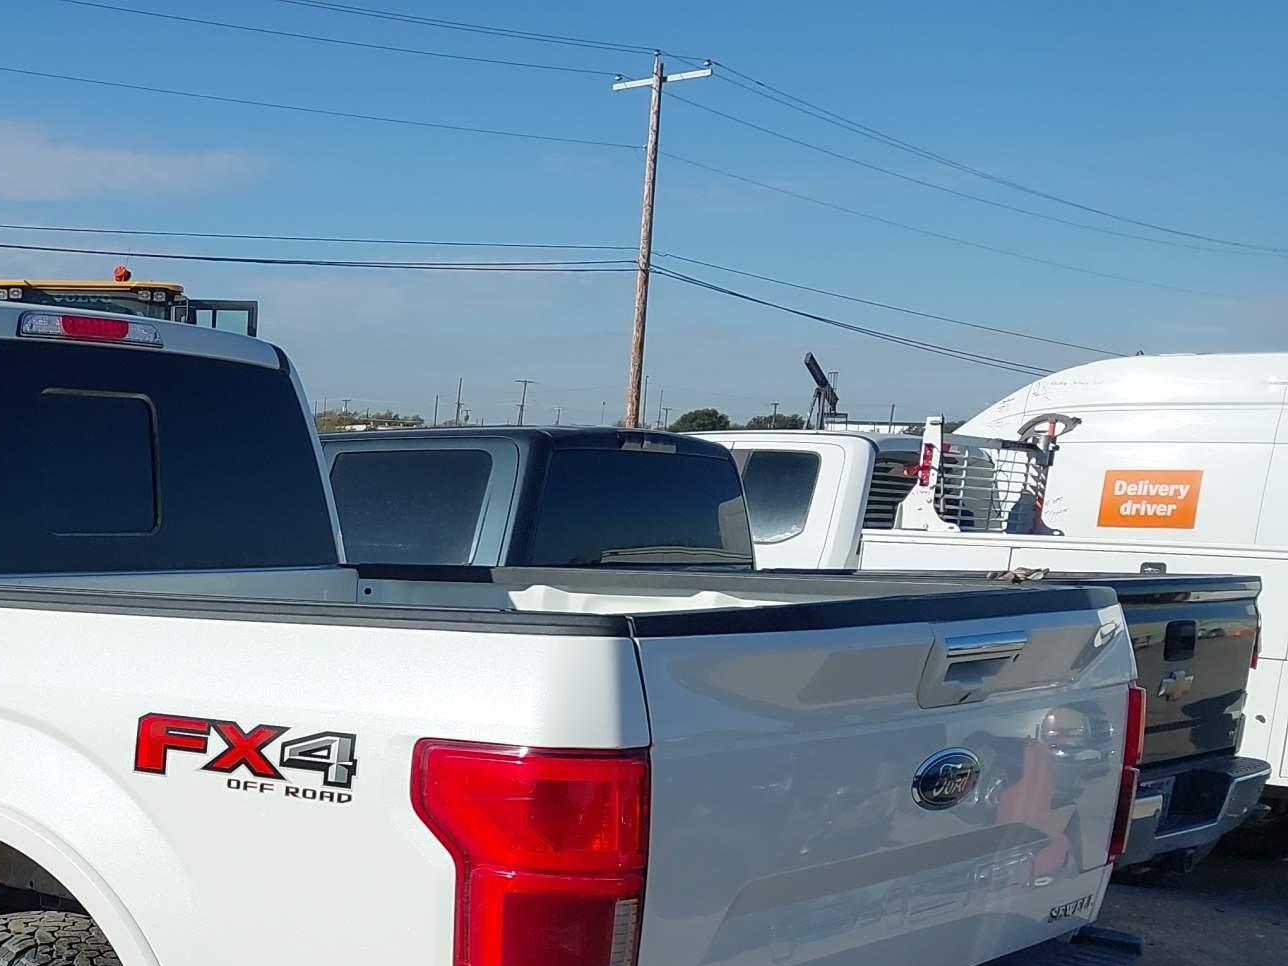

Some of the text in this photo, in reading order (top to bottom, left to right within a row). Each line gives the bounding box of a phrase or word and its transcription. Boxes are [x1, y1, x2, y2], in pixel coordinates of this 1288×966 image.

[1113, 479, 1191, 500] Delivery
[1119, 499, 1178, 517] driver
[133, 711, 359, 789] FX4
[226, 778, 353, 804] OFF ROAD
[932, 762, 972, 797] Ford
